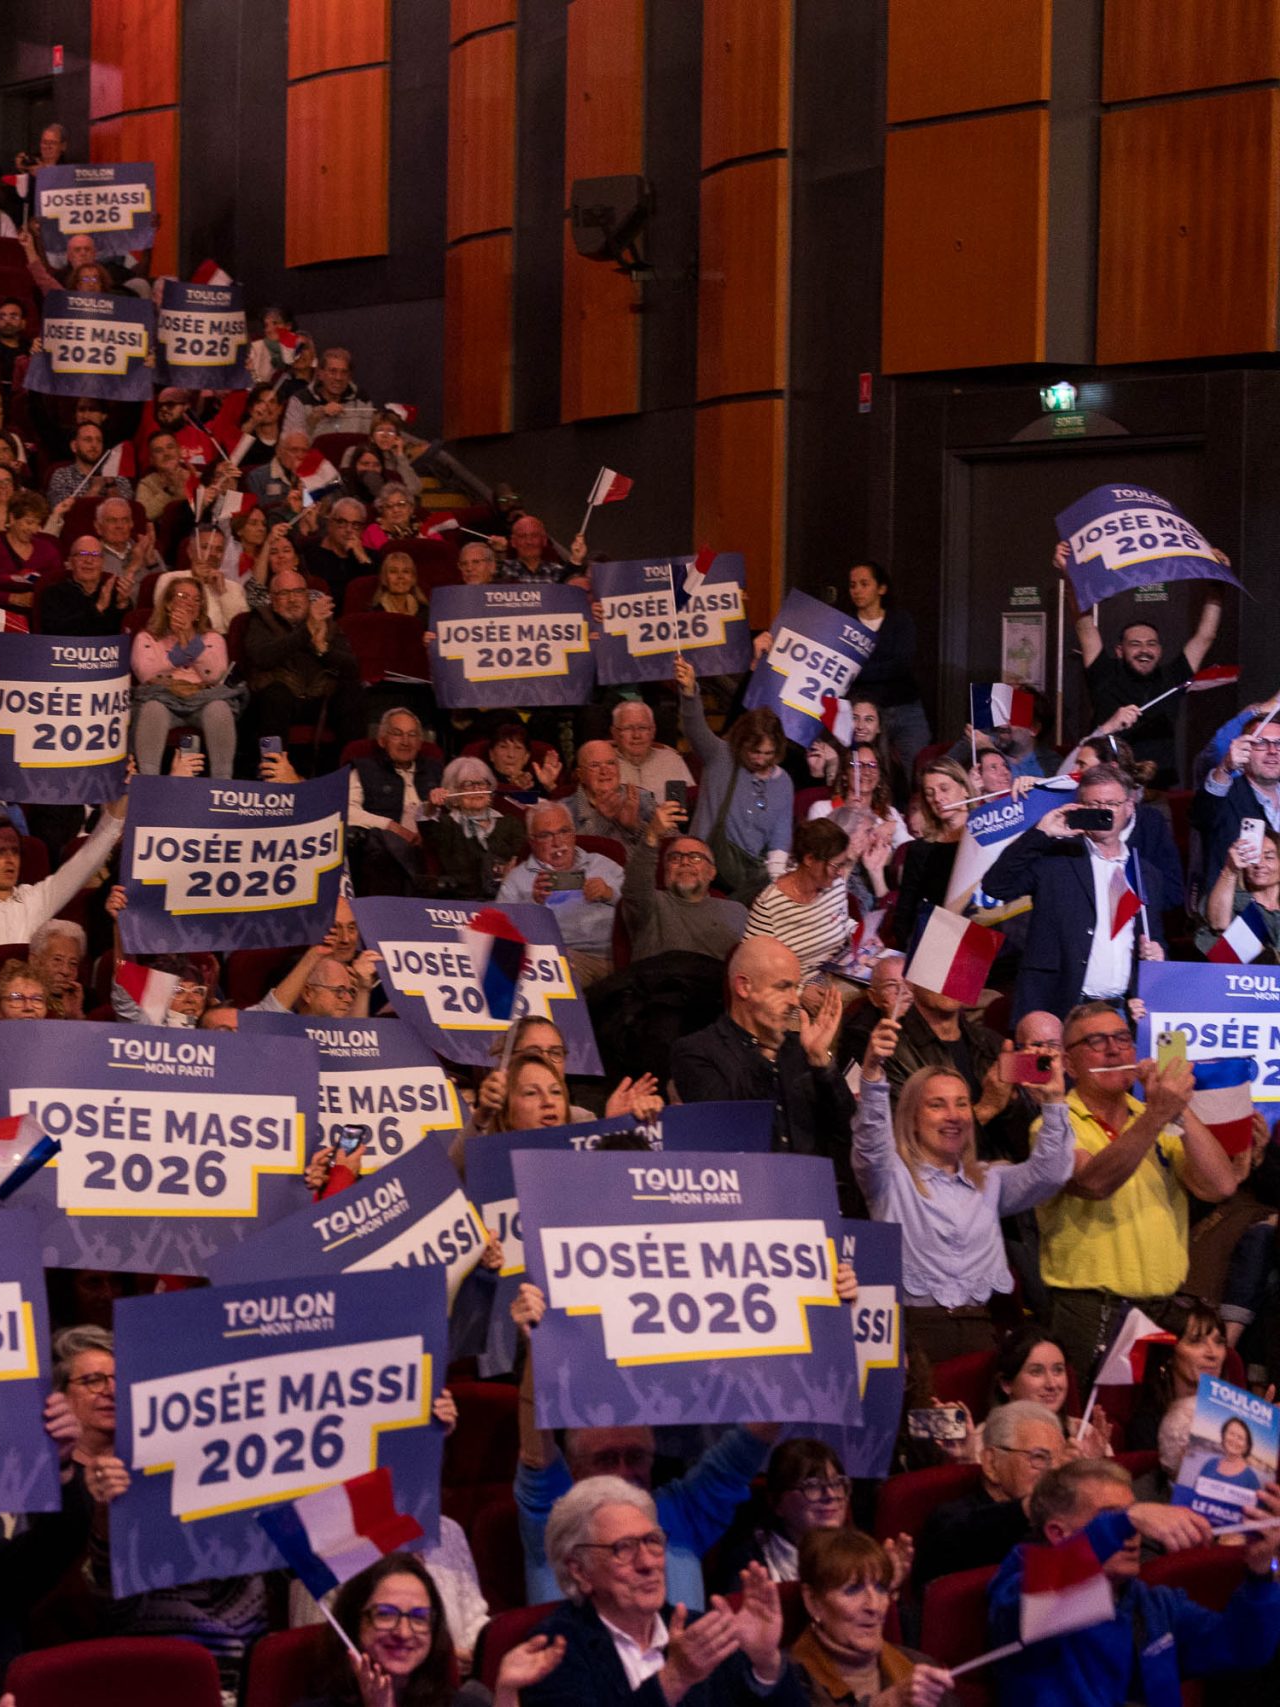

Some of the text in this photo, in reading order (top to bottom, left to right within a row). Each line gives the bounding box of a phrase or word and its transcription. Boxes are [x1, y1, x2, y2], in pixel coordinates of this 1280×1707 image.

[44, 191, 145, 207] JOSÉE MASSI
[69, 206, 121, 225] 2026
[44, 322, 143, 348] JOSÉE MASSI
[158, 315, 203, 334] JOSÉE
[58, 345, 117, 366] 2026
[174, 338, 230, 357] 2026
[1077, 513, 1151, 552] JOSÉE
[1115, 532, 1200, 555] 2026
[485, 592, 541, 602] TOULON
[606, 596, 668, 620] JOSÉE
[442, 621, 582, 643] JOSÉE MASSI
[639, 615, 708, 642] 2026
[51, 647, 120, 662] TOULON
[477, 643, 552, 668] 2026
[776, 636, 849, 685] JOSÉE
[33, 718, 121, 751] 2026
[209, 789, 295, 809] TOULON
[238, 808, 263, 817] MON
[967, 801, 1024, 834] TOULON
[138, 832, 339, 864] JOSÉE MASSI
[186, 864, 297, 898] 2026
[392, 947, 476, 978] JOSÉE
[305, 1028, 379, 1047] TOULON
[108, 1038, 216, 1065] TOULON
[145, 1063, 216, 1079] MON PARTI
[349, 1083, 448, 1114] MASSI
[164, 1111, 292, 1152] MASSI
[84, 1151, 227, 1198] 2026
[628, 1168, 740, 1191] TOULON
[312, 1178, 404, 1241] TOULON
[669, 1192, 741, 1204] MON PARTI
[355, 1216, 384, 1238] MON
[553, 1233, 827, 1280] JOSÉE MASSI
[223, 1291, 336, 1327] TOULON
[628, 1283, 776, 1334] 2026
[260, 1316, 336, 1337] MON PARTI
[138, 1363, 417, 1439] JOSÉE MASSI
[1210, 1380, 1273, 1420] TOULON
[198, 1414, 345, 1486] 2026
